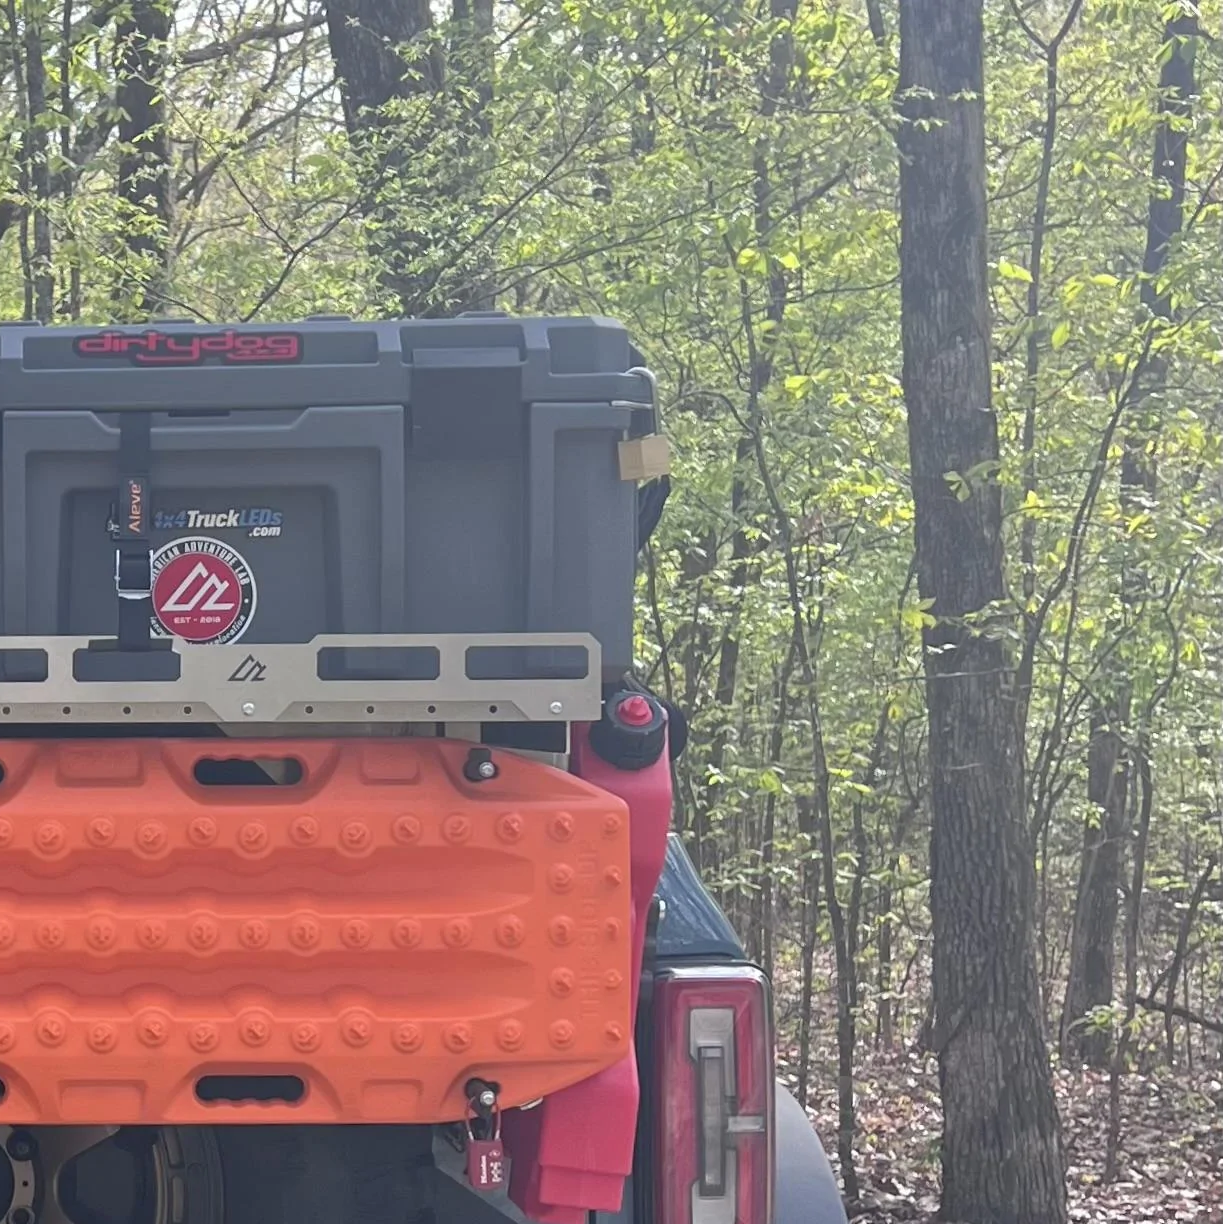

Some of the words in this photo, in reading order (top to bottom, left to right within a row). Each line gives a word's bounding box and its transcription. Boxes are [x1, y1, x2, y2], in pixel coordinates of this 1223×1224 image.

[79, 331, 298, 361] dirtydog
[248, 526, 281, 537] .com
[184, 541, 238, 566] ADVENTURE
[235, 565, 250, 585] LAB
